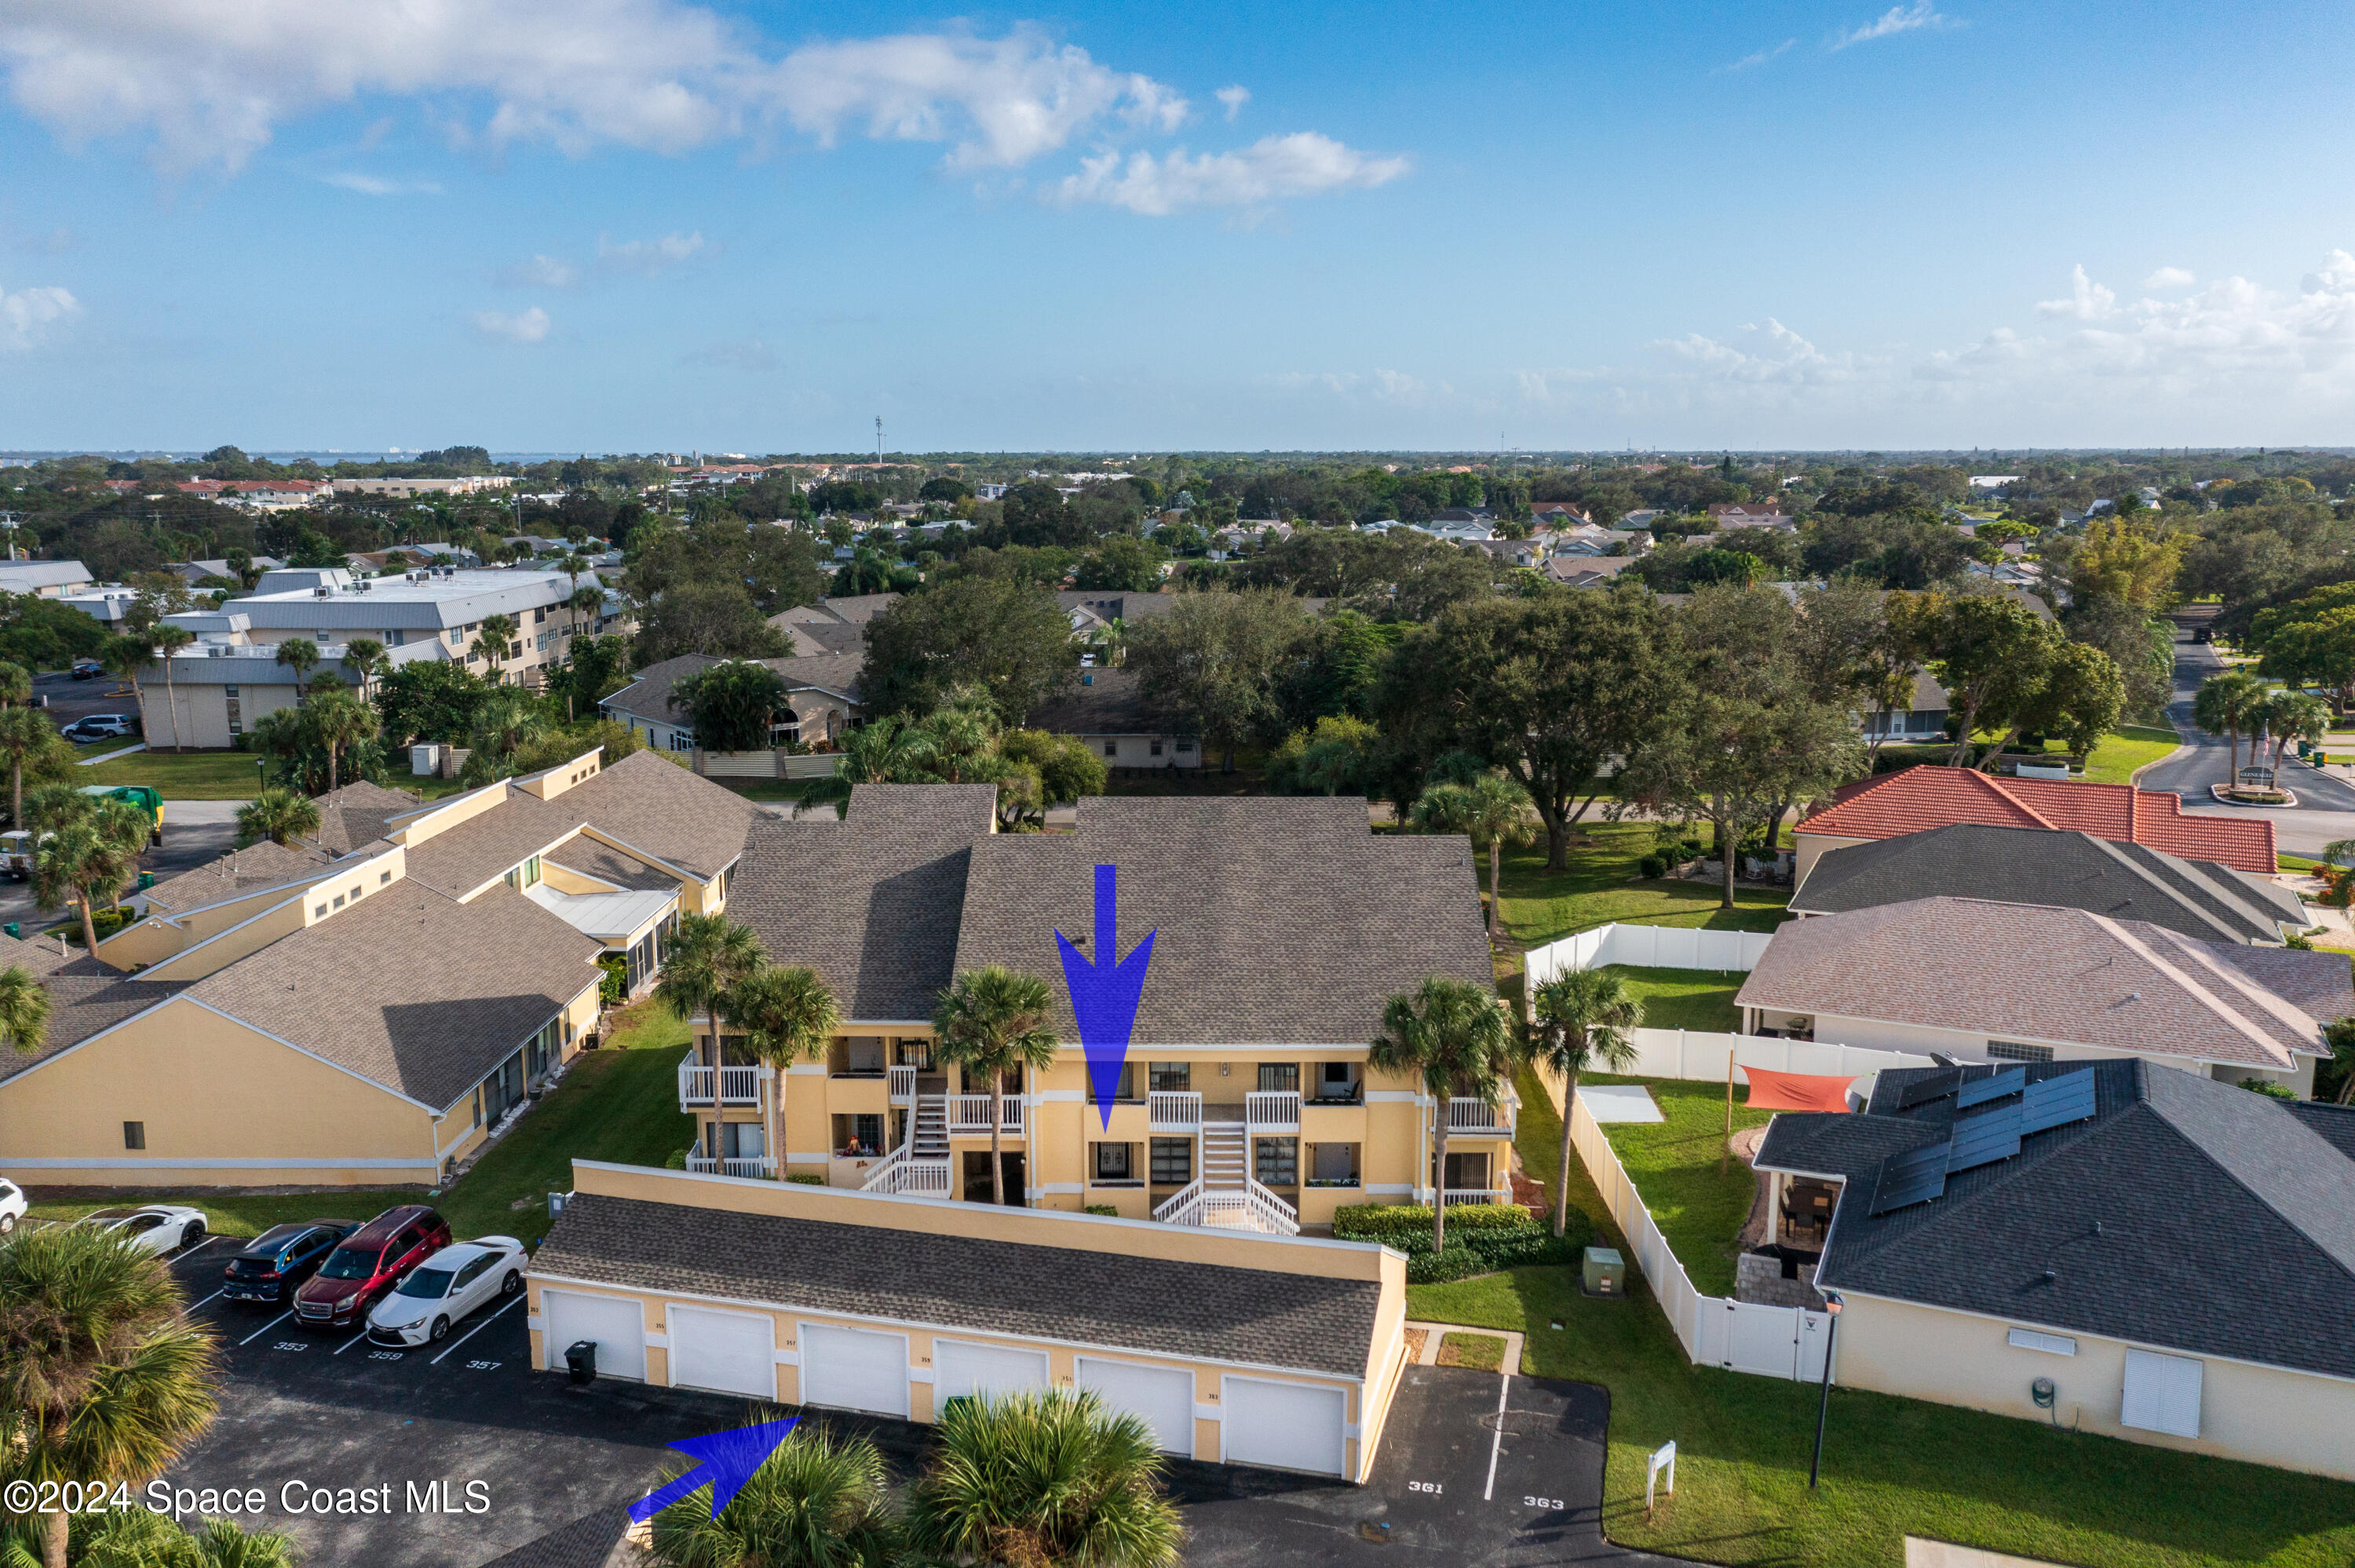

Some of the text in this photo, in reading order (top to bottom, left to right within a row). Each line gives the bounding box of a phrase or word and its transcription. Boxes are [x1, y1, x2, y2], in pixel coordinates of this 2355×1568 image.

[273, 1341, 308, 1351] 353
[367, 1351, 403, 1360] 359
[466, 1360, 502, 1370] 357
[1408, 1481, 1443, 1494] 361
[1524, 1495, 1565, 1511] 363
